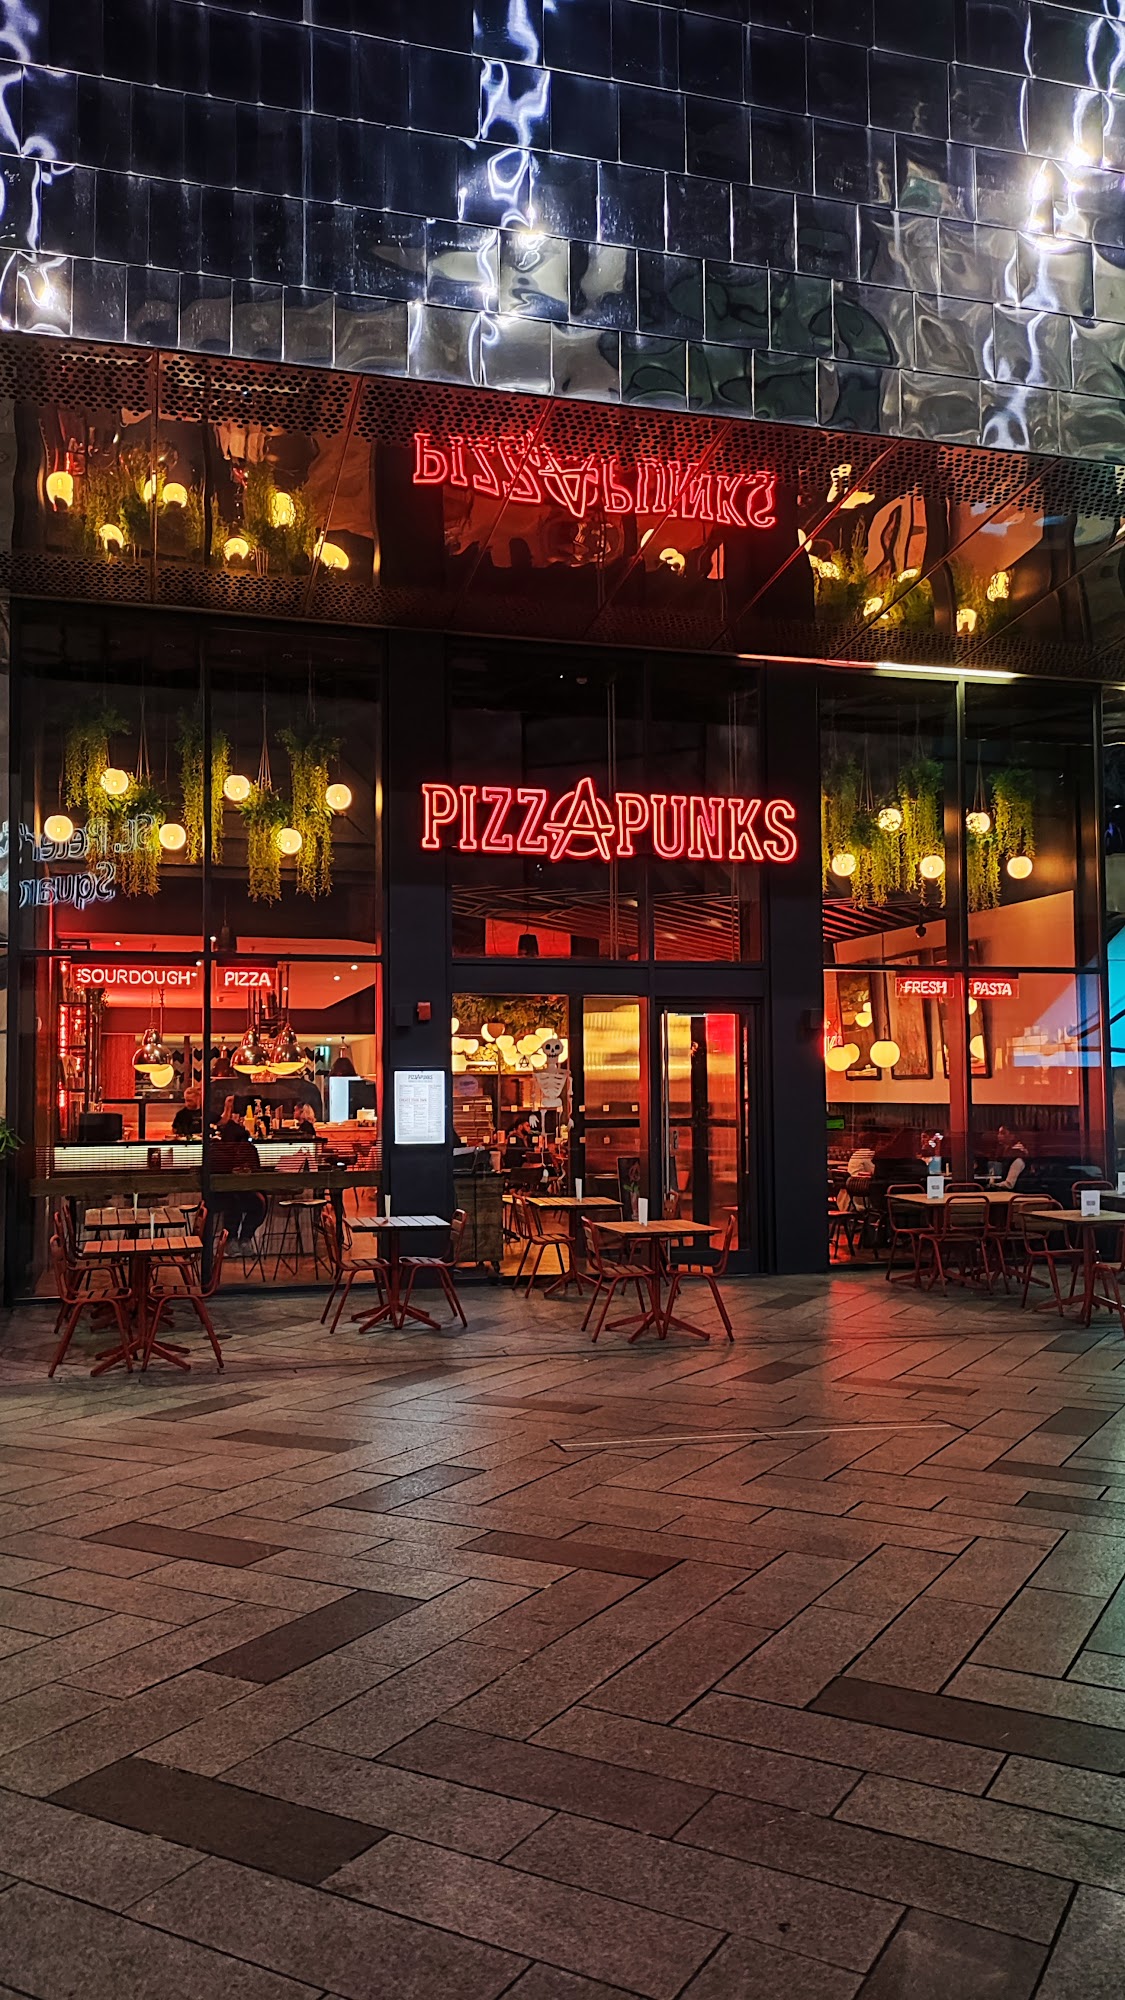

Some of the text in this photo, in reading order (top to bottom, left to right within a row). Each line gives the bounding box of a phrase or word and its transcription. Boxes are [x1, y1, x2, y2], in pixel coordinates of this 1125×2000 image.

[80, 968, 271, 987] SOURDOUGH PIZZA
[905, 980, 1012, 996] FRESH PASTA
